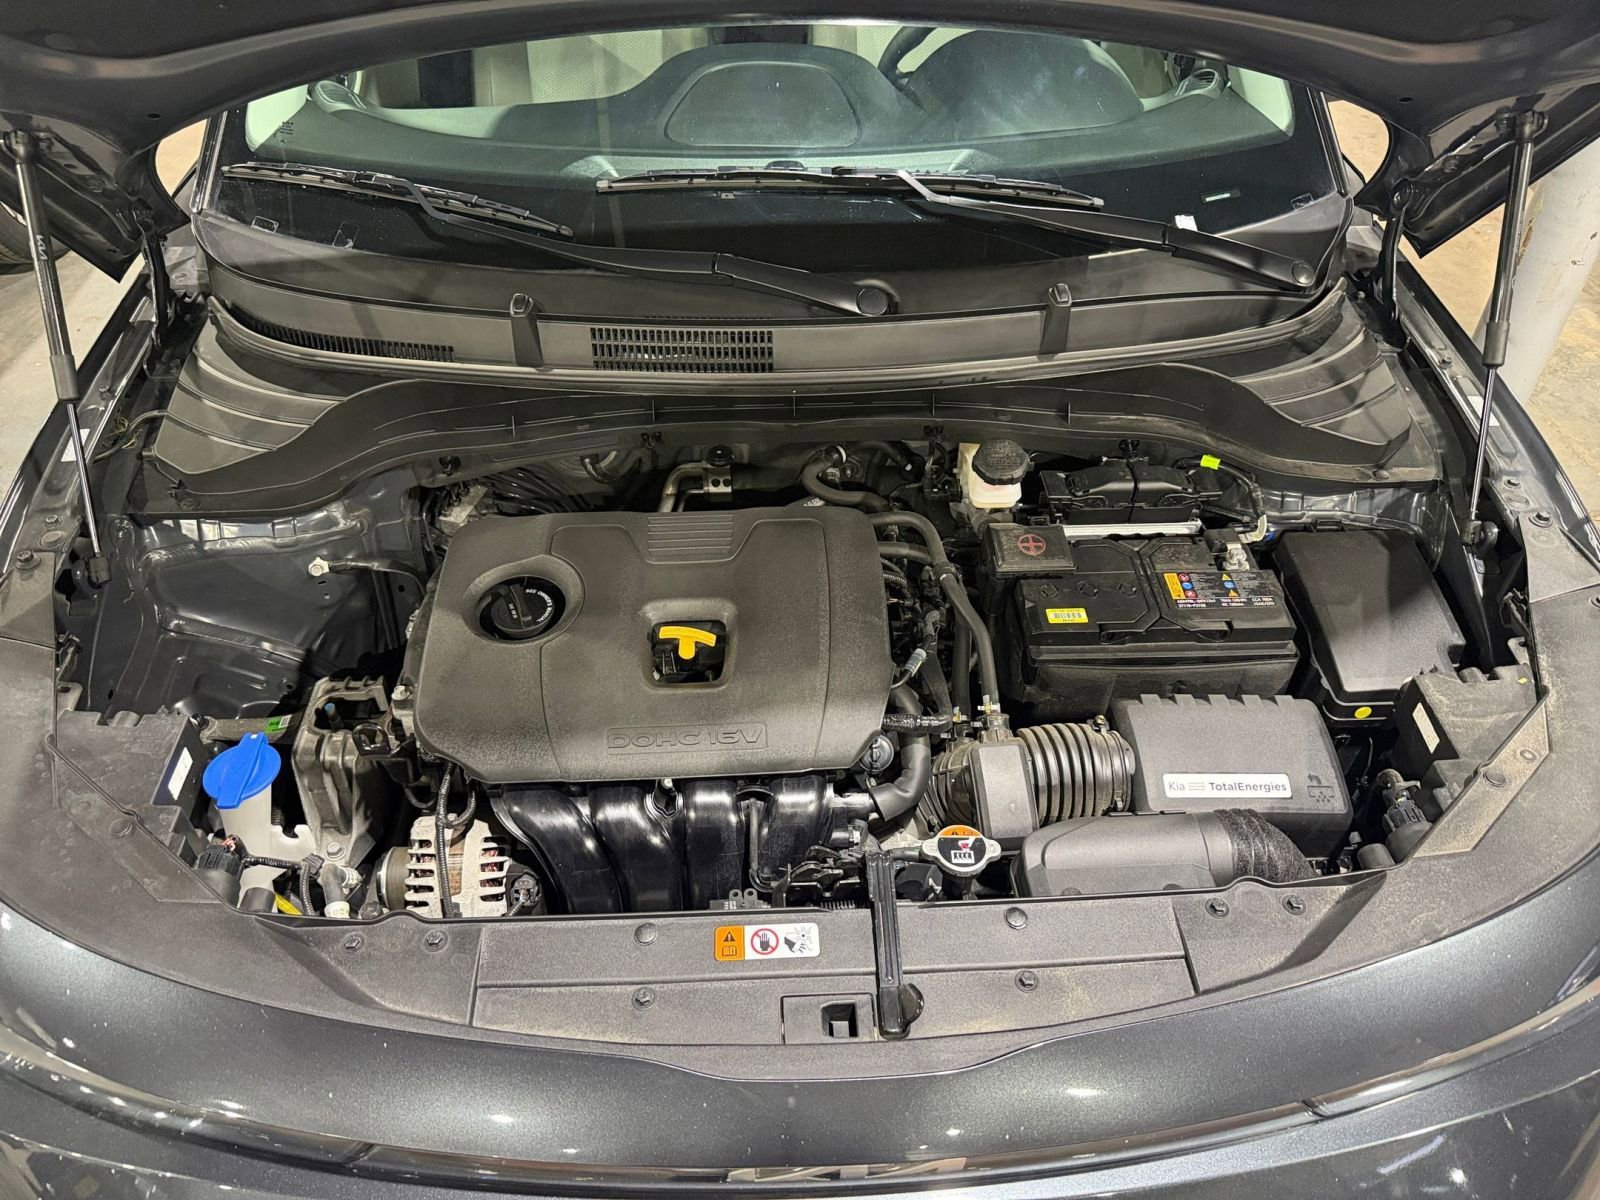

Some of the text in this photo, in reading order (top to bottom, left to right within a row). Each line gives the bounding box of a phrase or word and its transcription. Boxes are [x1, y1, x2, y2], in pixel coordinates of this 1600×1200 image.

[608, 728, 764, 749] DOHC 16V
[1168, 781, 1287, 793] Kia TotalEnergies
